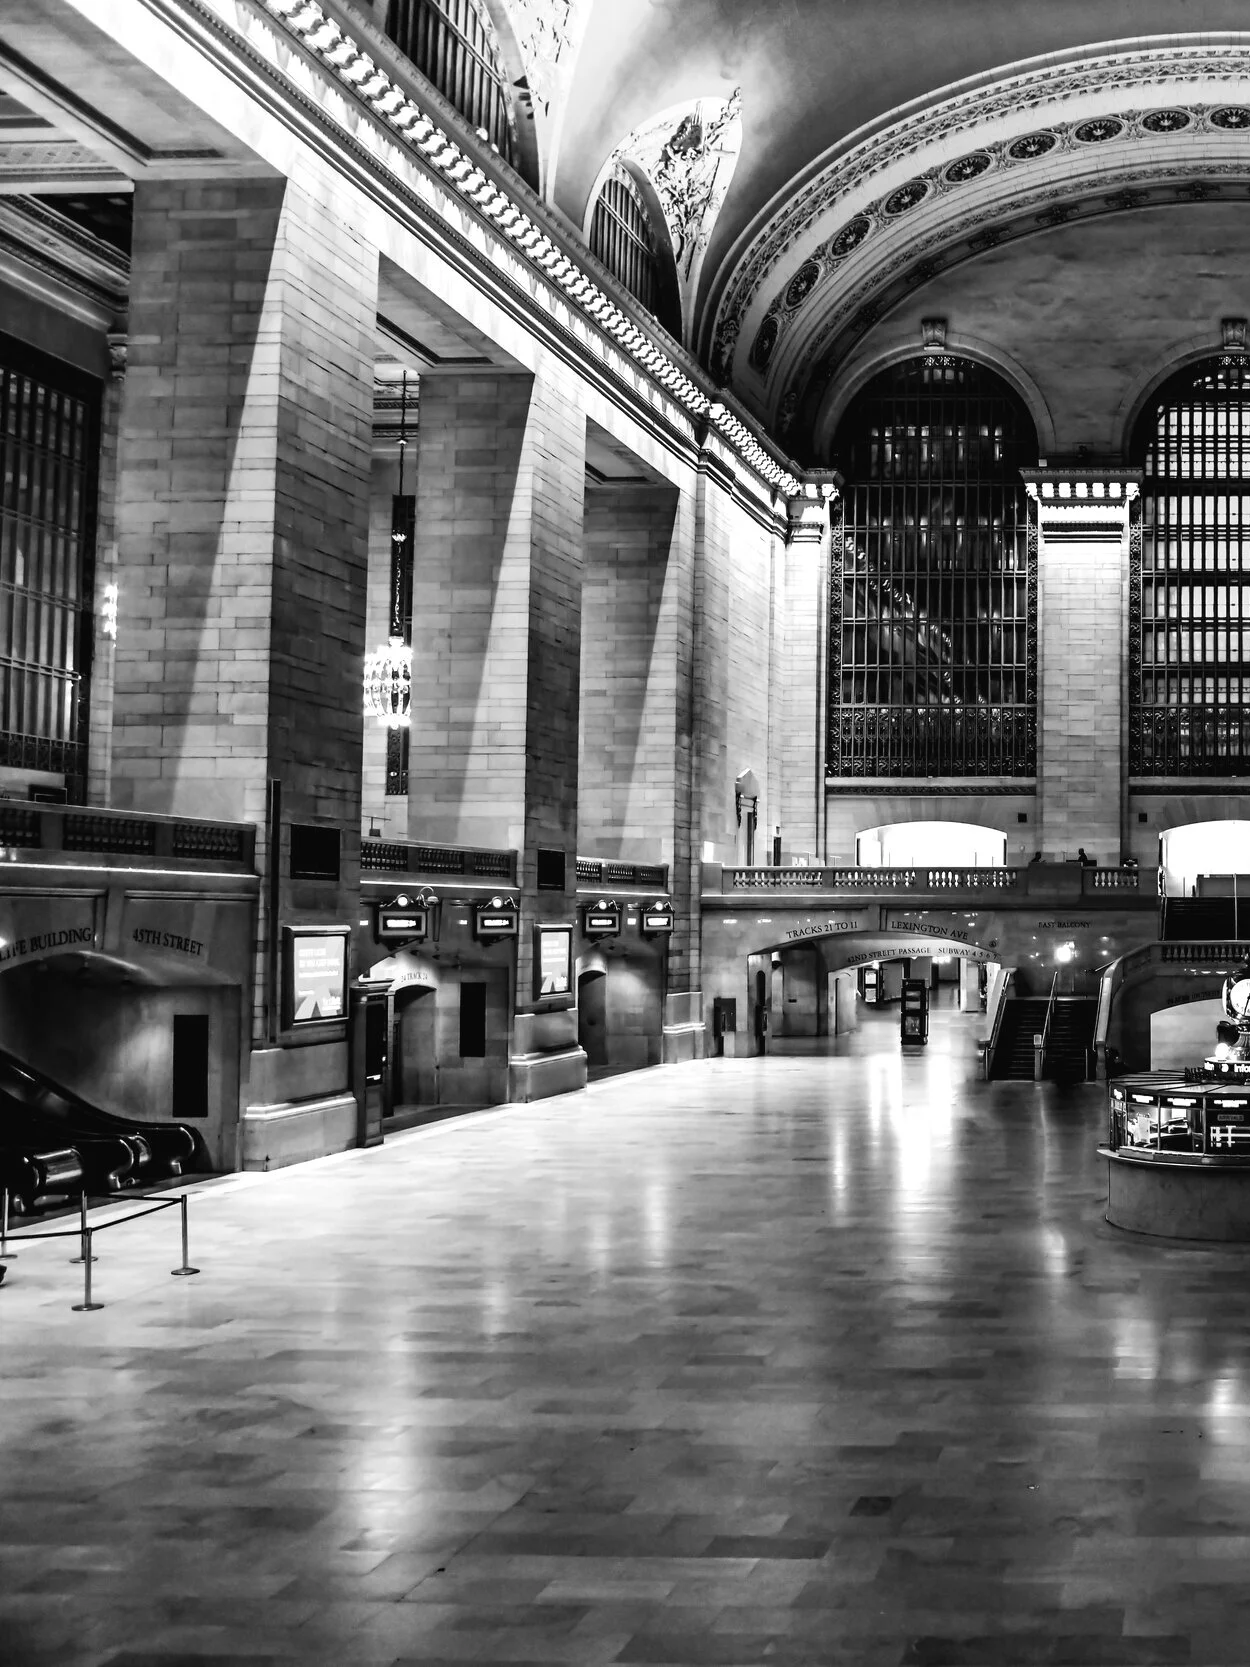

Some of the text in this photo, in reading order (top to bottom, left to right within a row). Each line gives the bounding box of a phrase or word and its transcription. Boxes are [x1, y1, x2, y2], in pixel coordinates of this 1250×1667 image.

[29, 927, 91, 952] BUILDING
[785, 925, 822, 938] TRACKS
[834, 922, 848, 930] TO
[891, 921, 968, 940] LEXINGTON AVE
[133, 928, 203, 955] 45TH STREET
[868, 949, 897, 958] STREET
[898, 947, 931, 955] PASSAGE
[938, 947, 970, 956] SUBWAY
